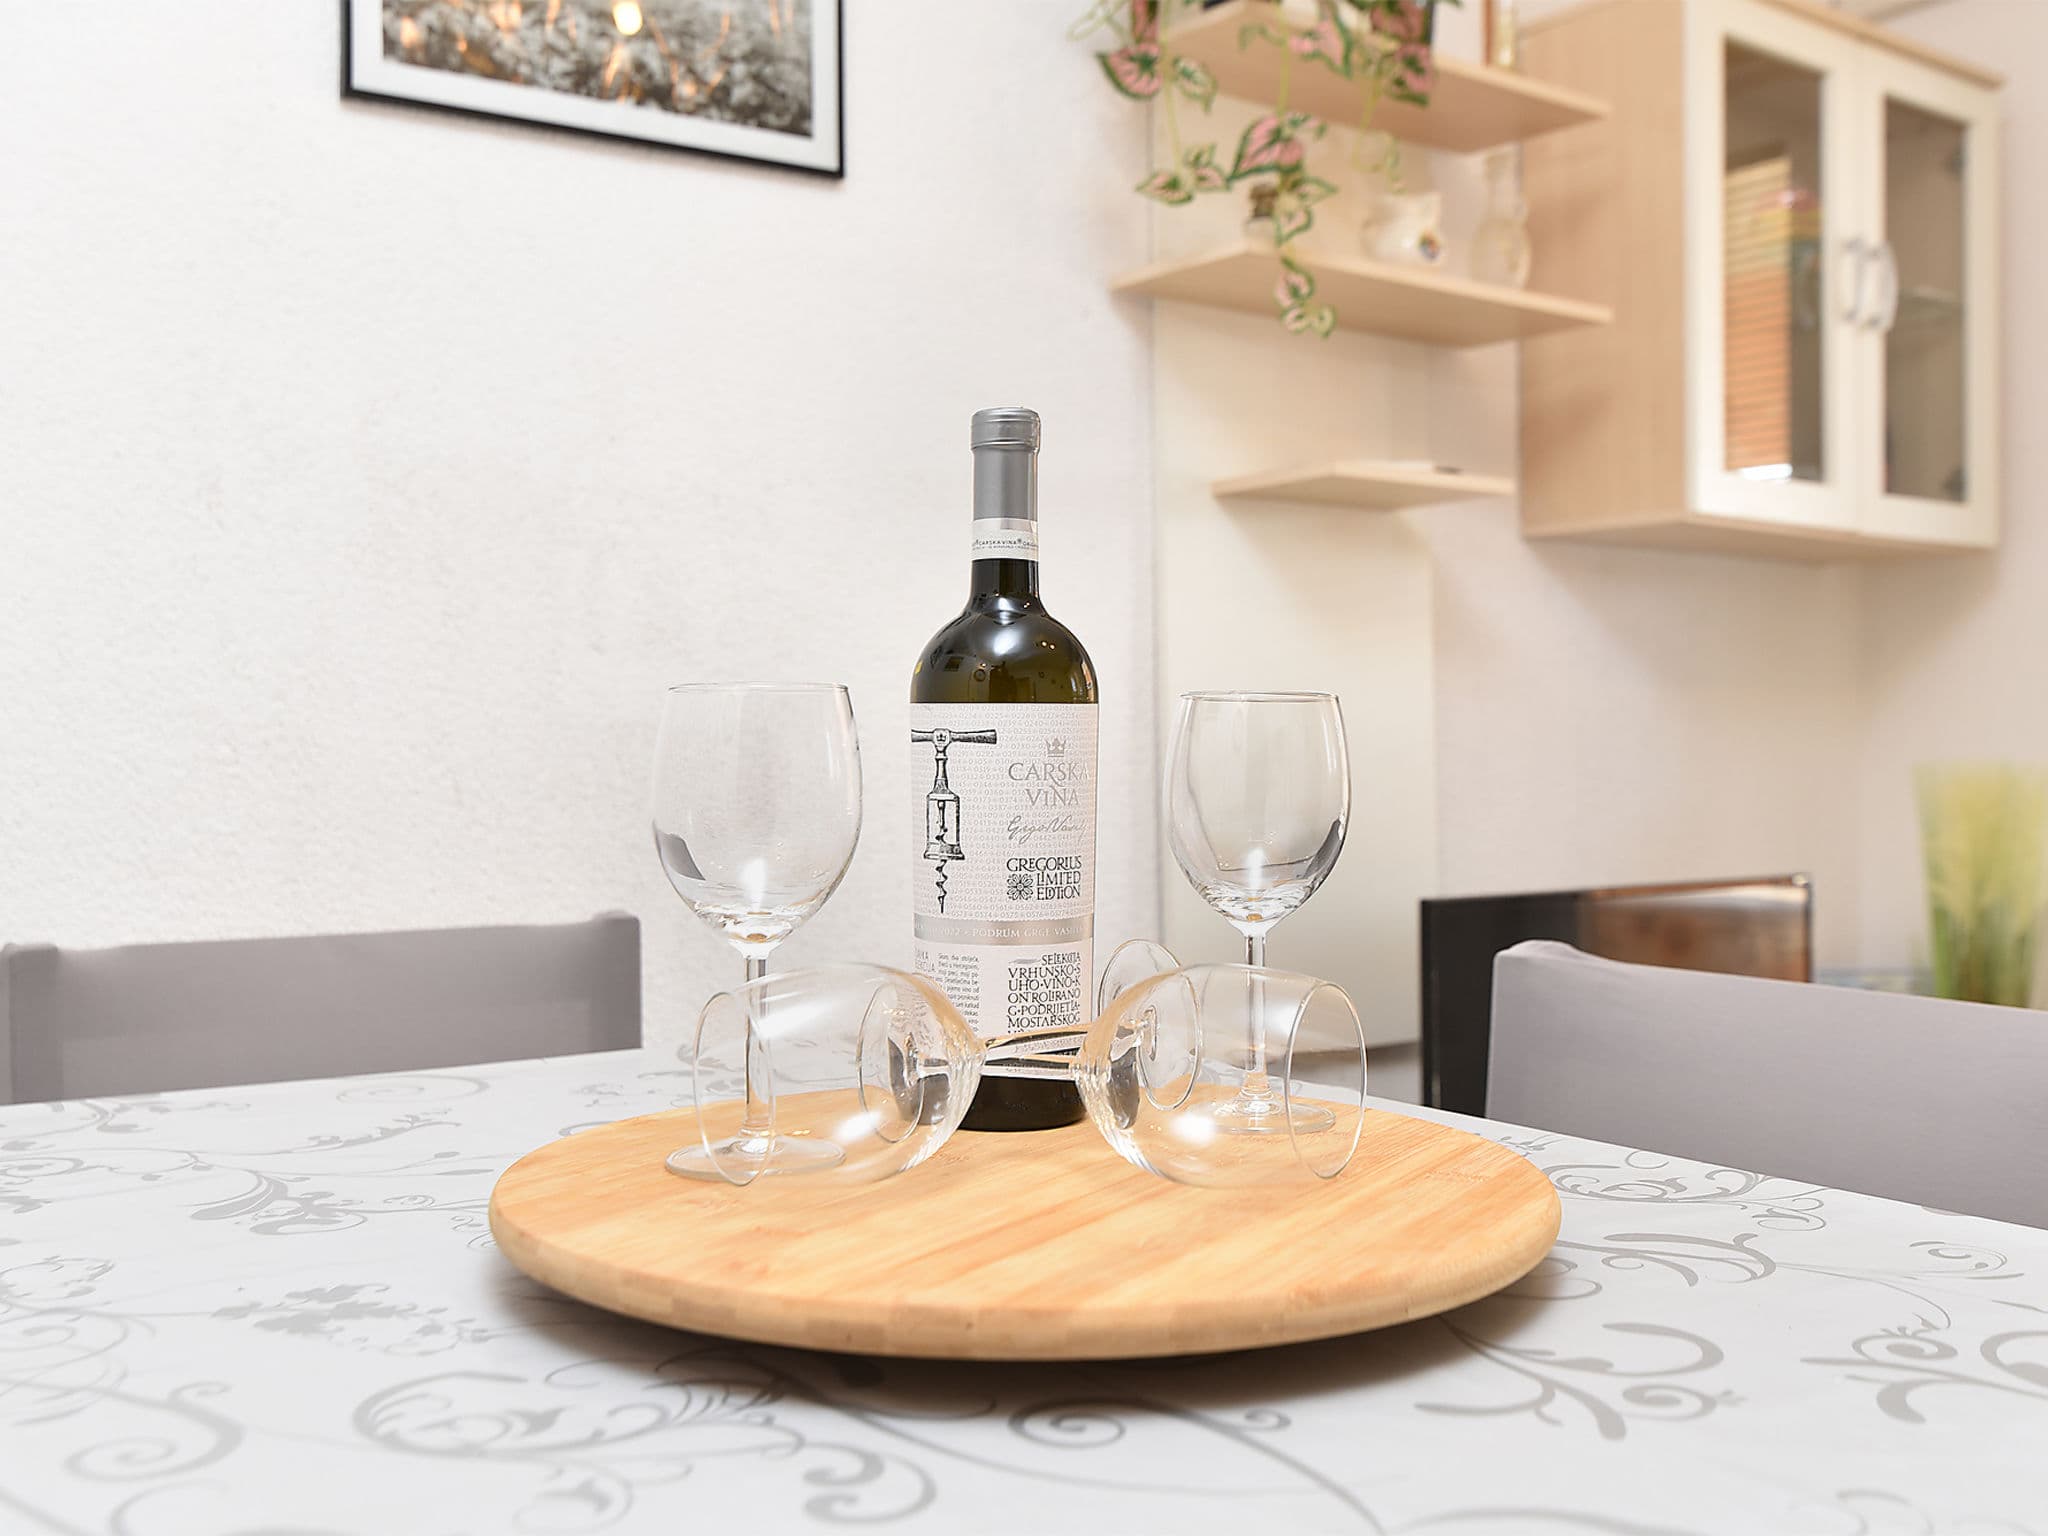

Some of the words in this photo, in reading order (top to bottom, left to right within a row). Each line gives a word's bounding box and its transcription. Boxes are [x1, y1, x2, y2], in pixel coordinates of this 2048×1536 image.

[1008, 762, 1088, 788] CARSKA
[1025, 785, 1079, 807] VINA
[1006, 855, 1082, 872] GREGORIUS
[1037, 871, 1081, 887] LIMITED
[972, 927, 1020, 938] PODRUM
[1006, 1012, 1081, 1029] MOSTARSKOG
